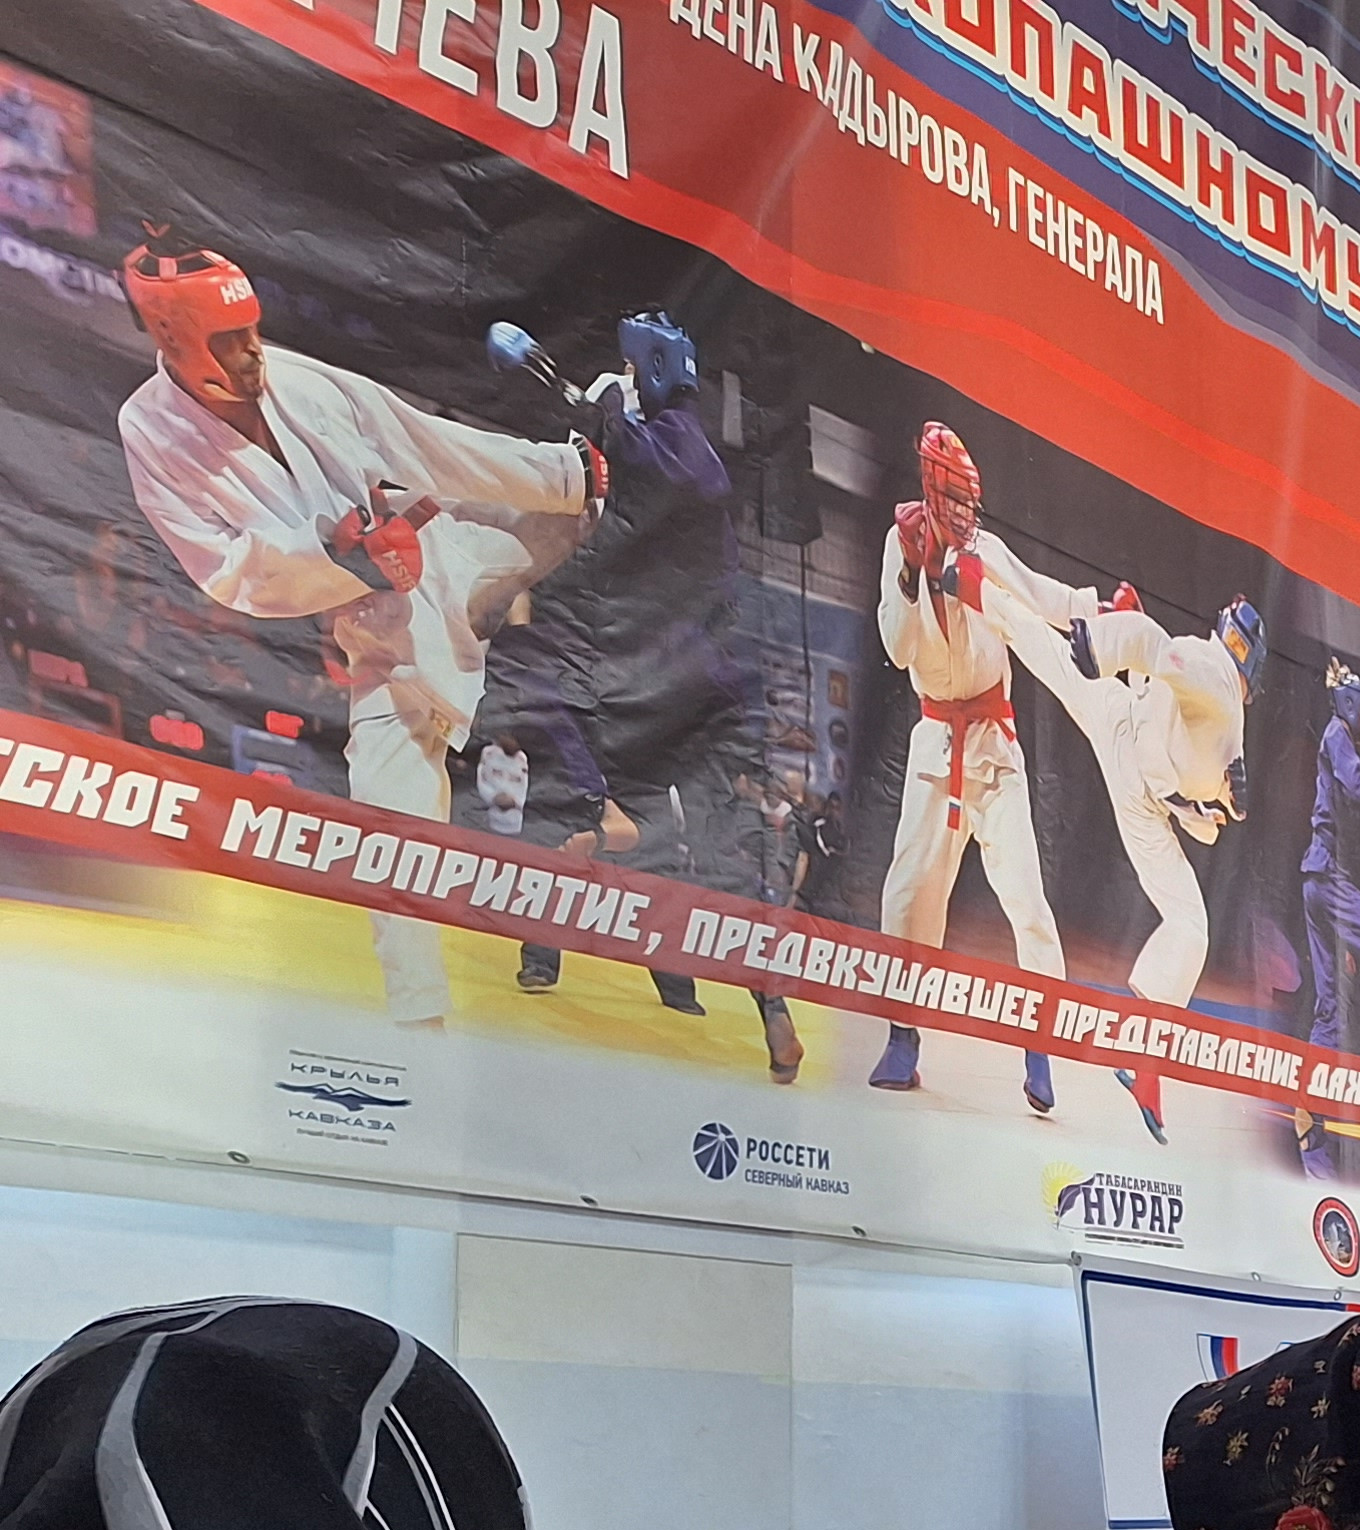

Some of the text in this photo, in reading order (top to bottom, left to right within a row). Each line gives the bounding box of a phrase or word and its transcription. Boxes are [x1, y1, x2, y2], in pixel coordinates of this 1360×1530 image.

[292, 0, 630, 180] ЕВА
[792, 21, 1000, 229] КАДЫРОВА,
[1007, 167, 1165, 325] ГЕНЕРАЛА
[0, 737, 200, 840] СКОЕ
[219, 797, 664, 956] МЕРОПРИЯТИЕ,
[681, 907, 1045, 1032] ПРЕДВКУШАВШЕЕ
[1052, 998, 1303, 1091] ПРЕДСТАВЛЕНИЕ
[290, 1062, 399, 1087] КРЫЛЬЯ
[288, 1109, 396, 1132] КАВКАЗА
[746, 1137, 830, 1170] РОССЕТИ
[744, 1168, 850, 1195] СЕВЕРНЫЙ КАВКАЗ
[1082, 1186, 1184, 1235] НУРАР
